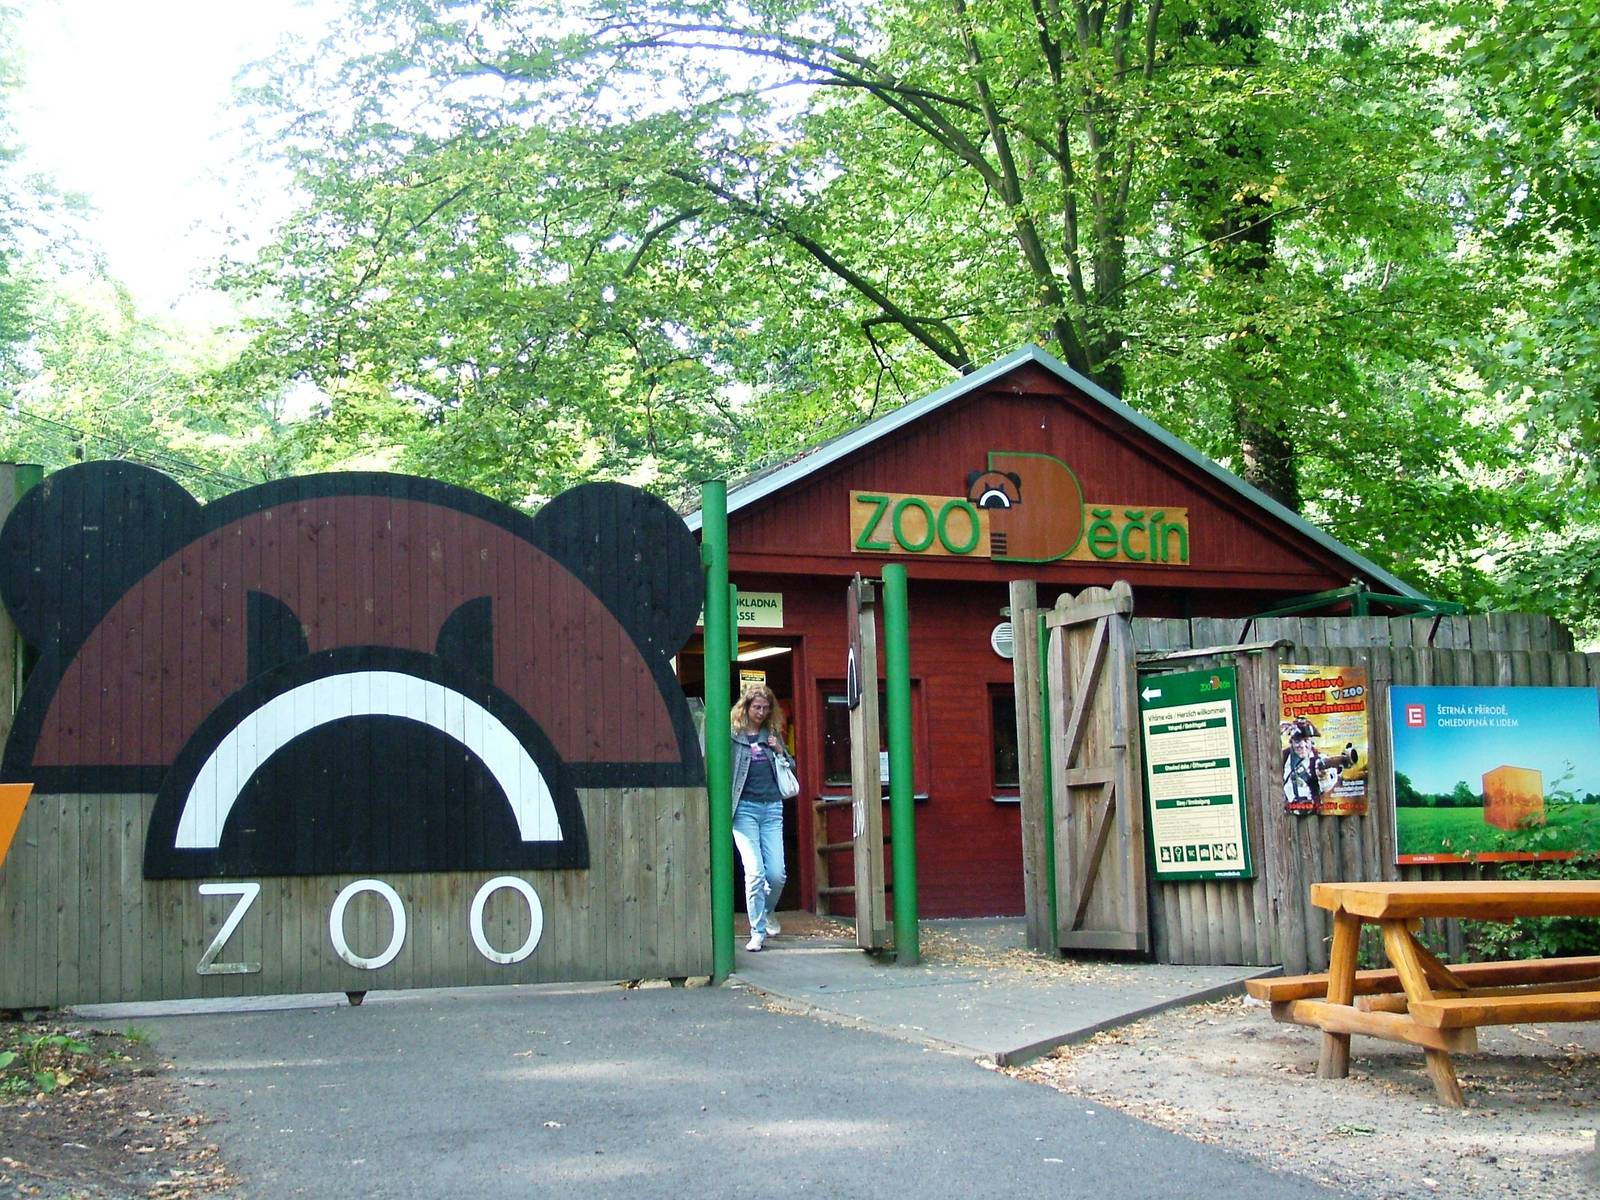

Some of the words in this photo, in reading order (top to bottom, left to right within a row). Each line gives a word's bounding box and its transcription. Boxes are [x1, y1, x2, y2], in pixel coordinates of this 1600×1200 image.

[855, 494, 980, 554] ZOO
[987, 451, 1188, 563] Děčín
[1282, 676, 1344, 691] Pohádkové
[1283, 690, 1326, 704] loučení
[1437, 704, 1466, 715] ŠETRNÁ
[1468, 706, 1473, 715] K
[1438, 717, 1488, 727] OHLEDUPLNÁ
[1490, 718, 1495, 727] K
[196, 876, 544, 975] ZOO
